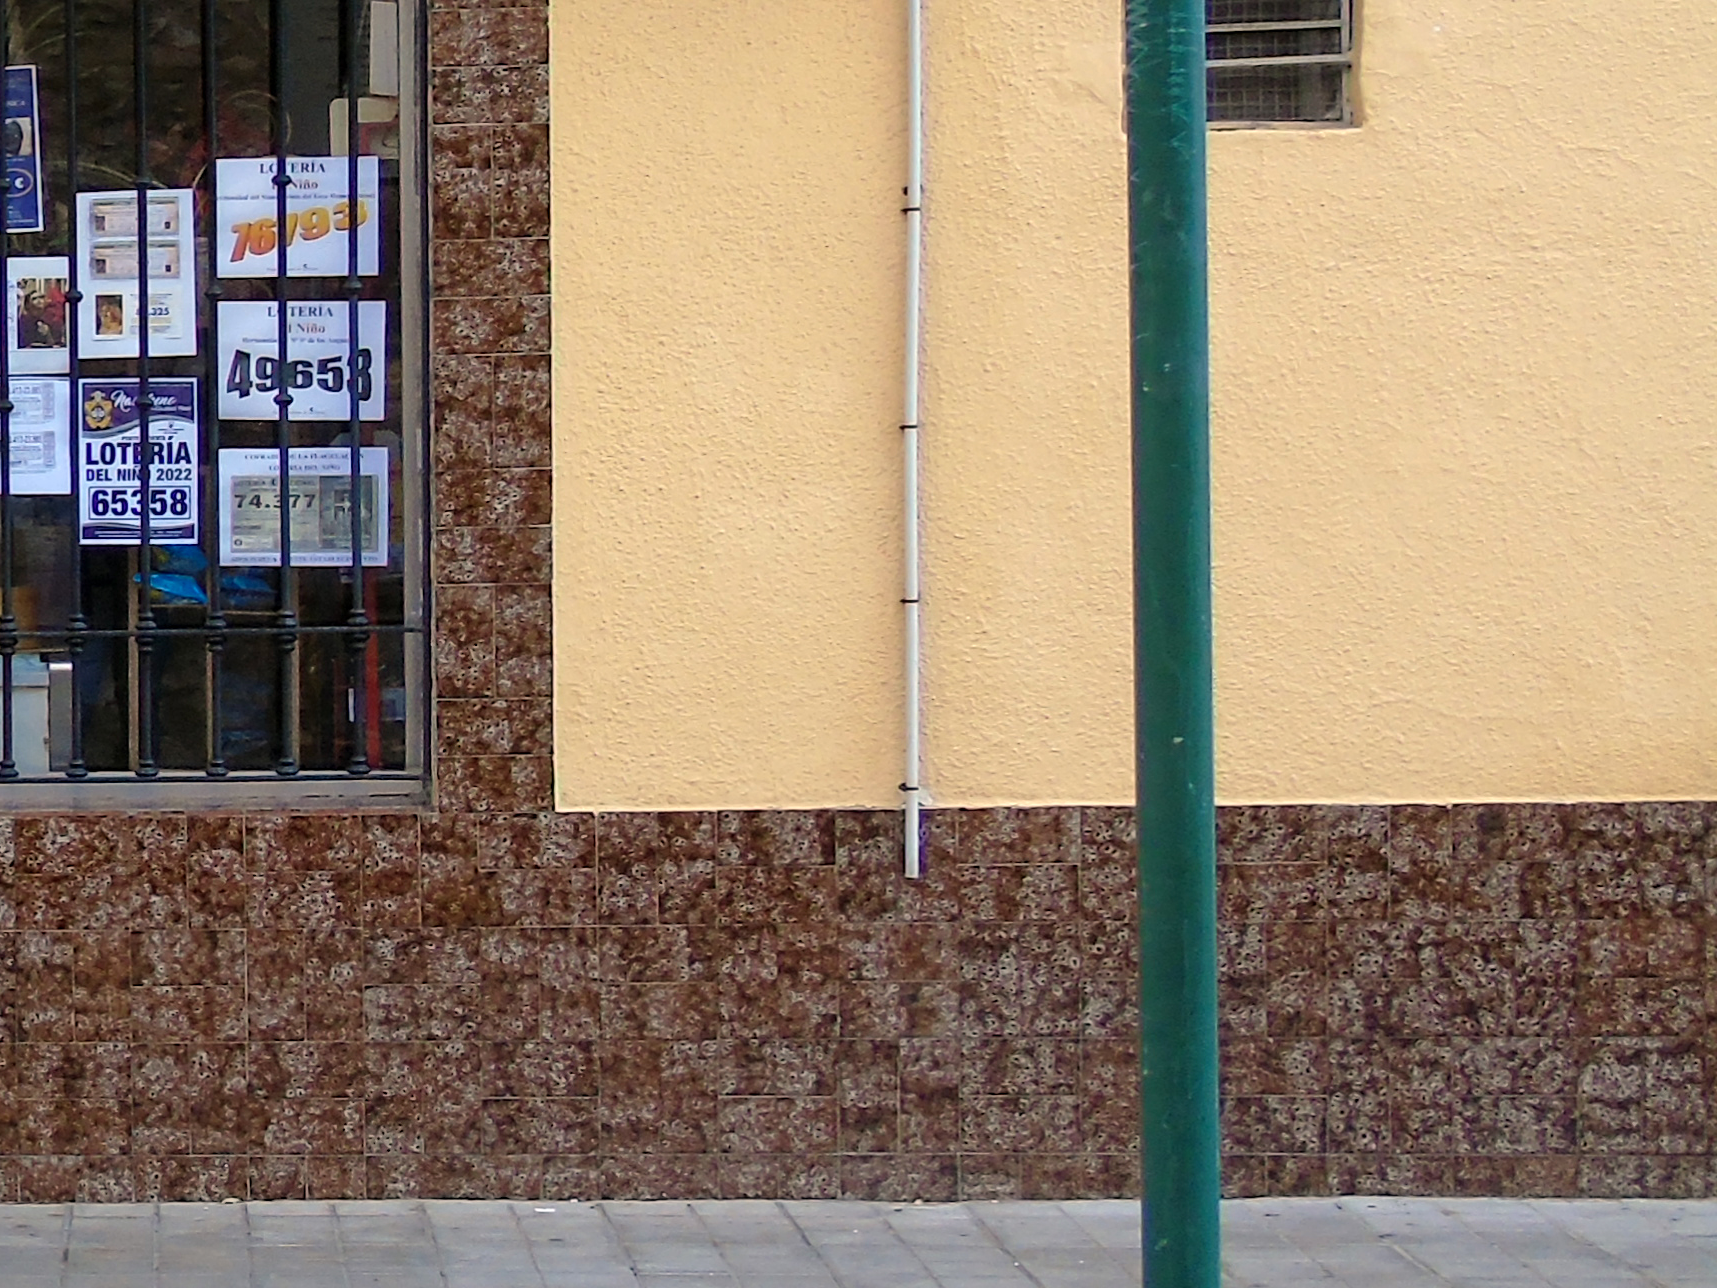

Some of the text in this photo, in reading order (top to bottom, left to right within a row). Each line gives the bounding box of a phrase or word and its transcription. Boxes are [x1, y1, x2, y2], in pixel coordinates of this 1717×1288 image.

[267, 305, 334, 318] LTERÍA
[226, 347, 373, 402] 49658
[110, 389, 177, 413] Nareno
[85, 437, 193, 466] LOTERÍA
[85, 465, 193, 482] DEL NIÑ 2022
[91, 488, 189, 517] 65358
